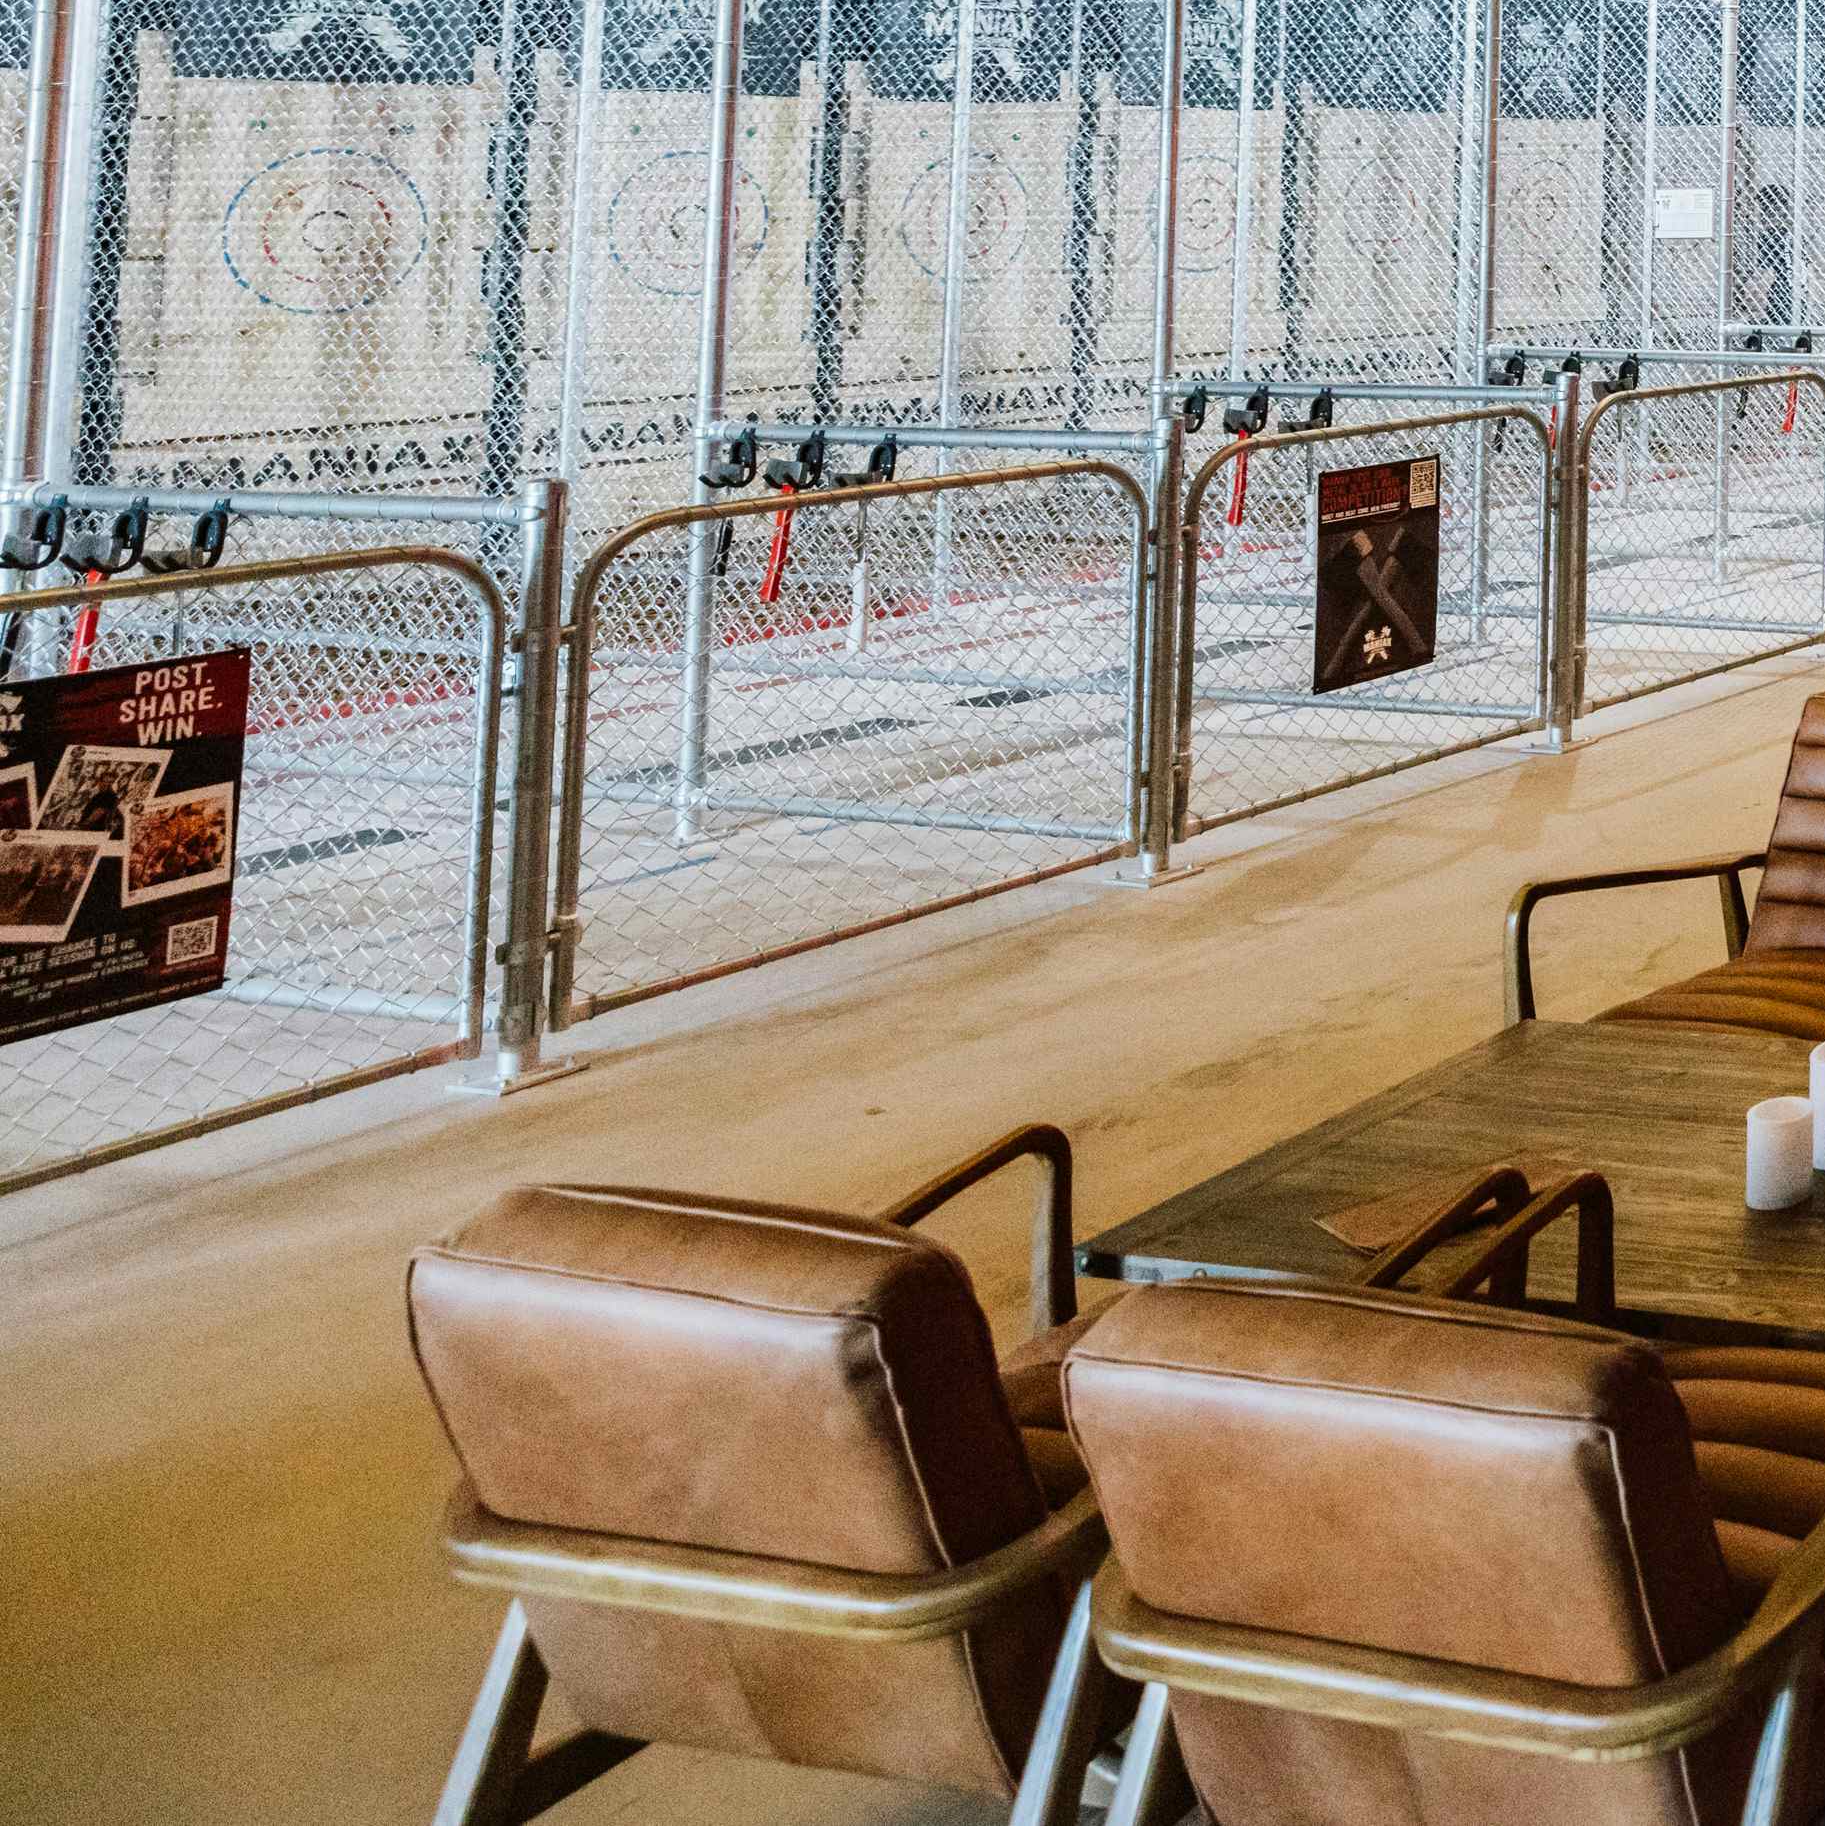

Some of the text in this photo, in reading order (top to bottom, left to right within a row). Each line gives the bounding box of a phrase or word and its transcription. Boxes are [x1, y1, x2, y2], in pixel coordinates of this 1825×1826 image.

[136, 662, 212, 695] POST.
[119, 686, 223, 724] SHARE.
[137, 715, 202, 747] WIN.
